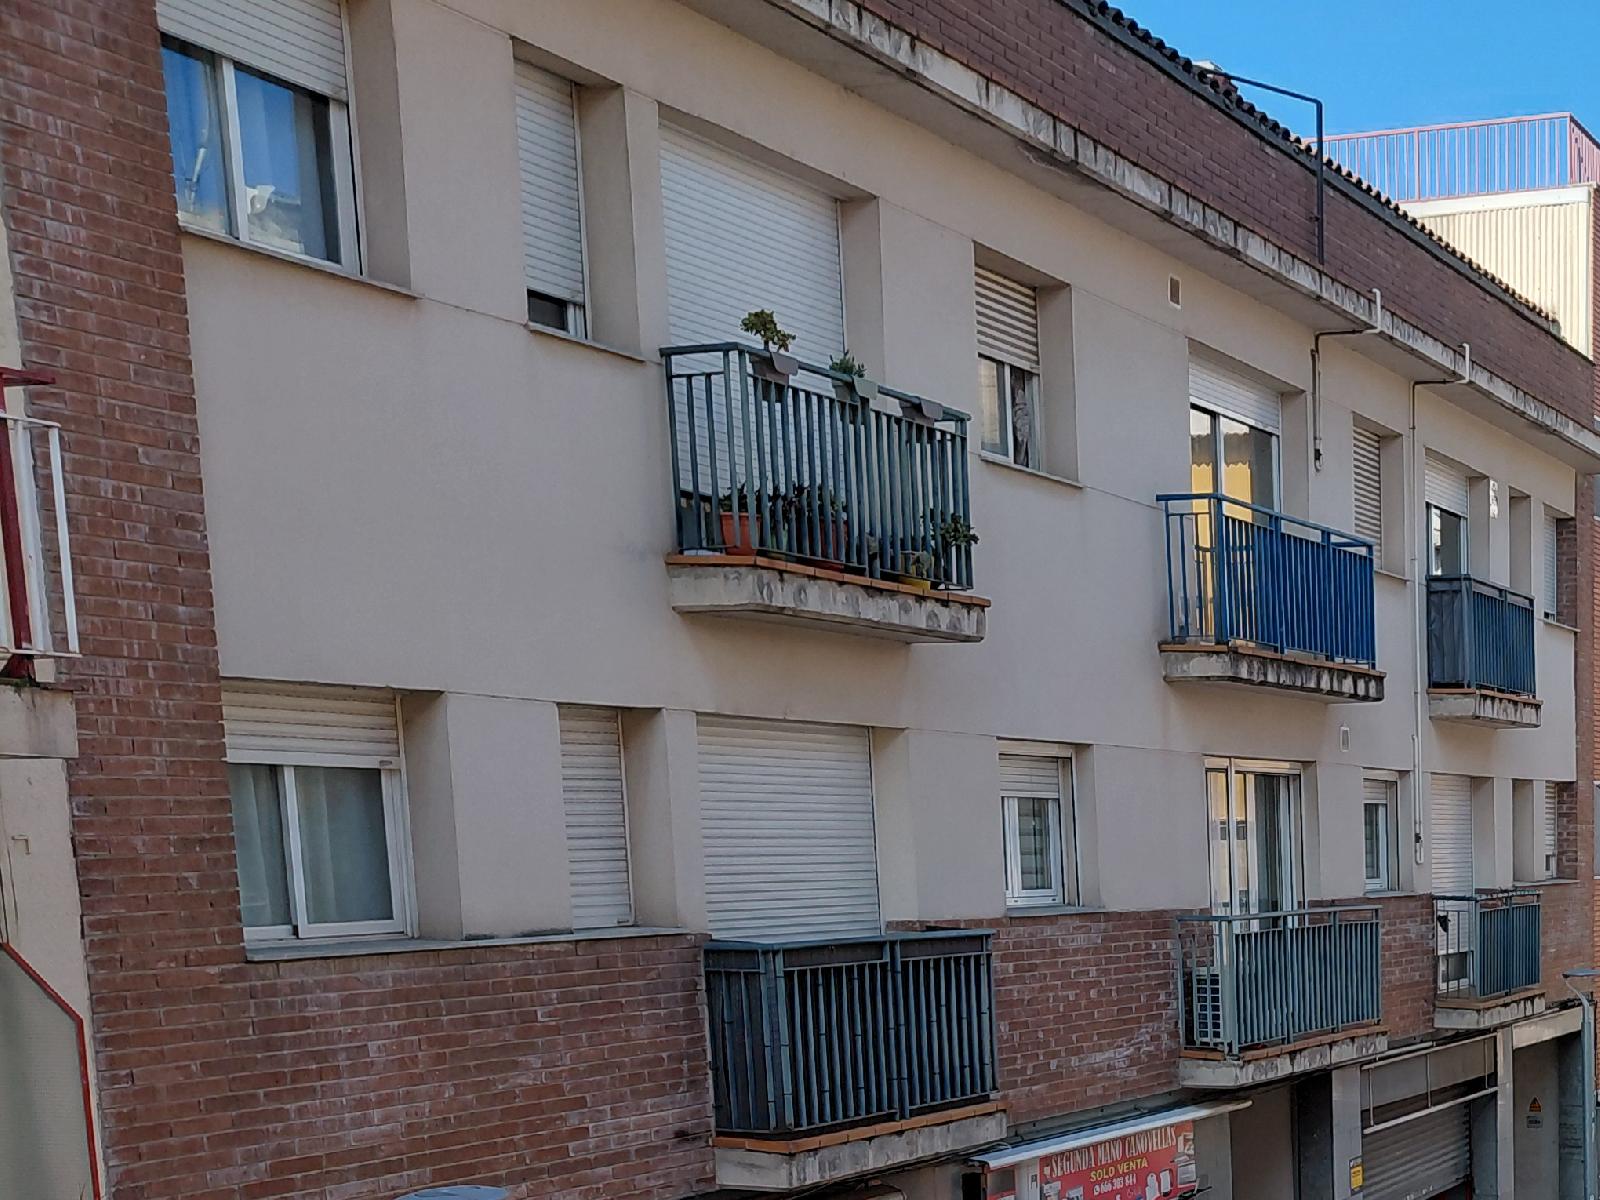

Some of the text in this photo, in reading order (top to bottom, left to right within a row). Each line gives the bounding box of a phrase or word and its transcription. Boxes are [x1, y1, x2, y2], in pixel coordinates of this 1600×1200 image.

[1097, 1140, 1123, 1166] MANO
[1090, 1157, 1149, 1182] SOLO VENTA
